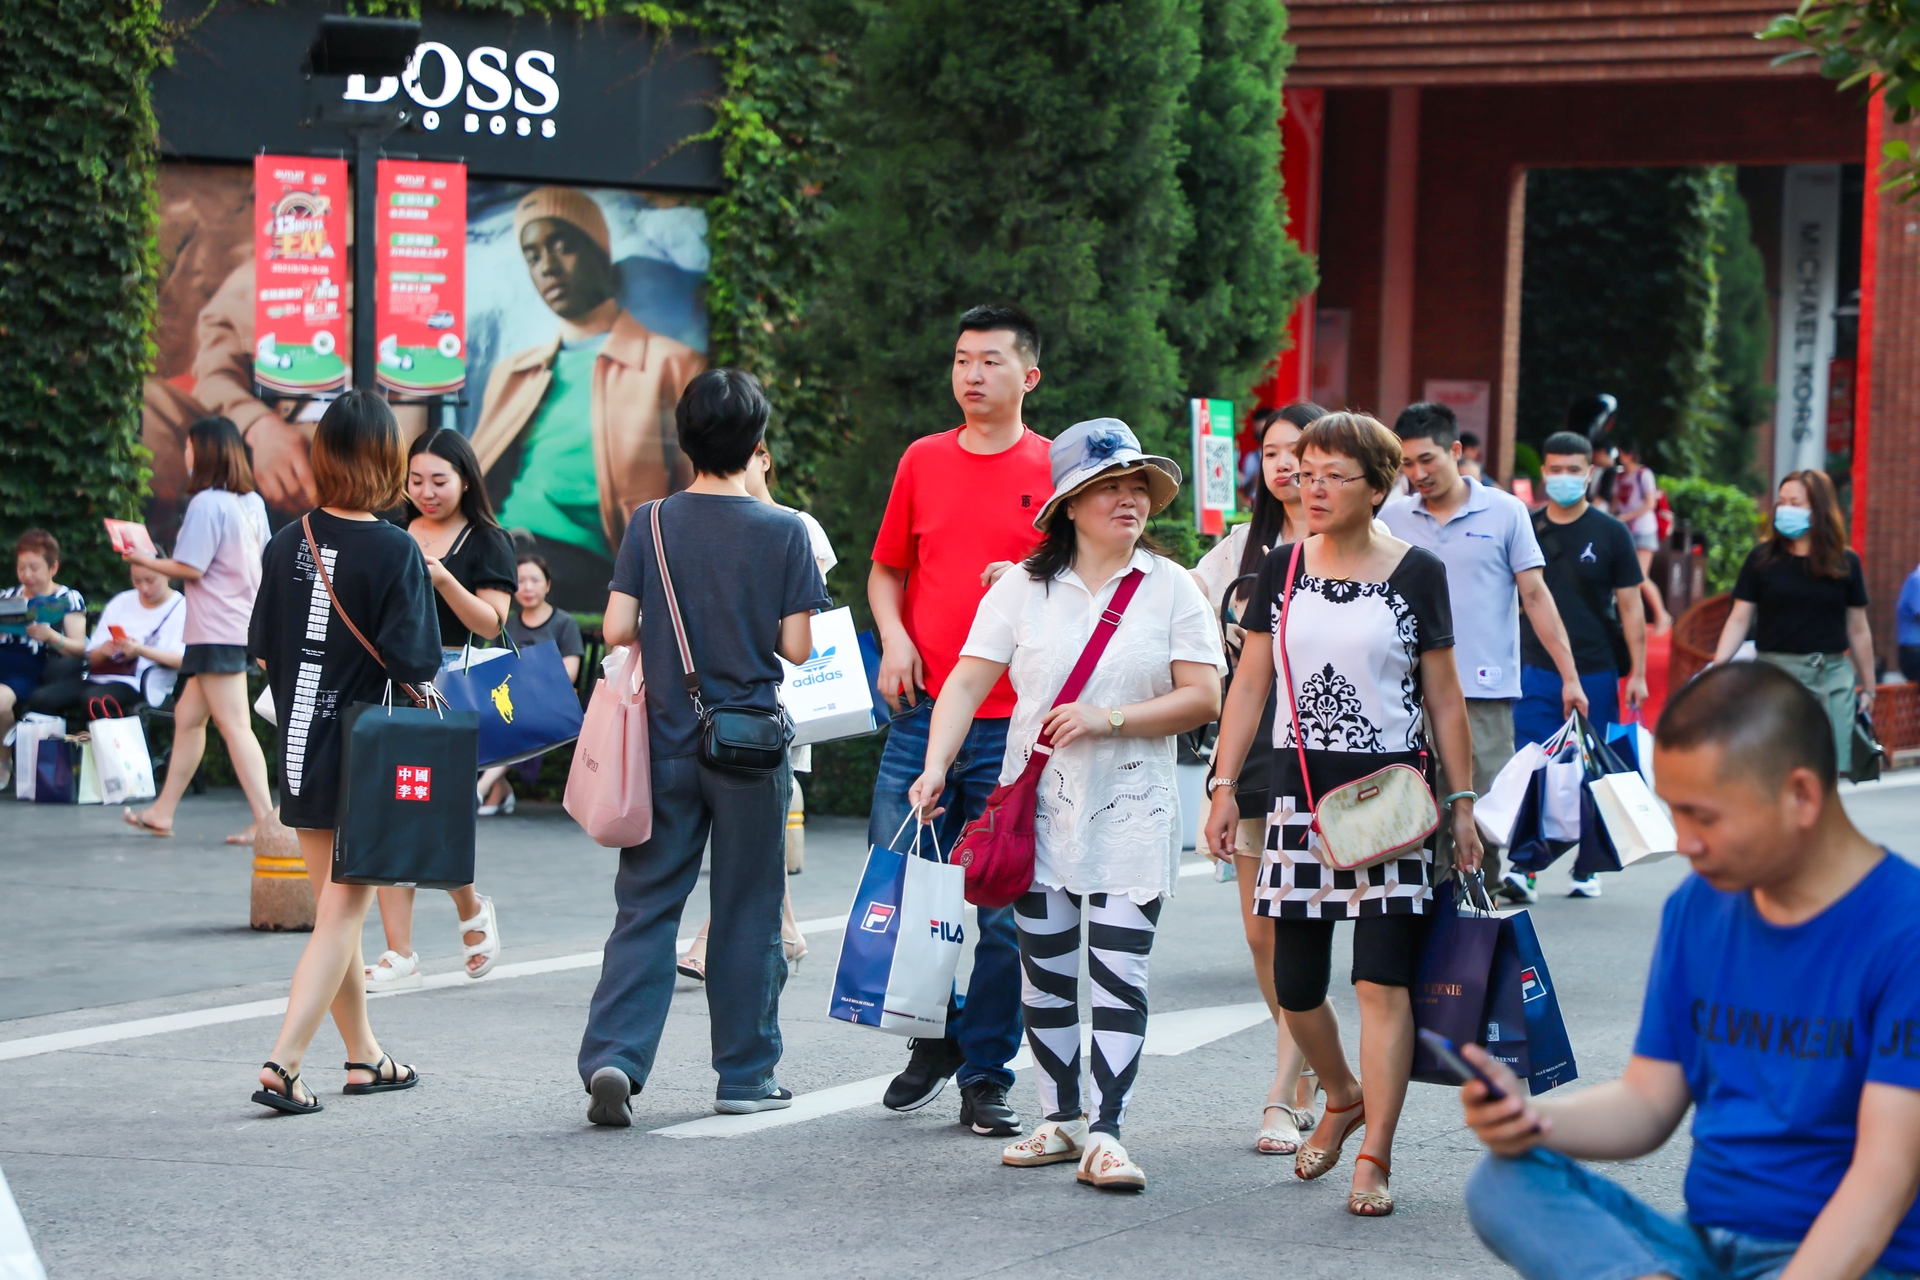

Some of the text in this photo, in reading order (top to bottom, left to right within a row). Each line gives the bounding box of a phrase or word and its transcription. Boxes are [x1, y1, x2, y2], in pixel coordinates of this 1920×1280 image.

[464, 113, 556, 138] BOSS
[1791, 222, 1820, 444] MICHAEL KORS
[792, 670, 843, 688] adidas
[398, 767, 428, 782] 中國
[398, 784, 428, 799] 李寧
[930, 919, 964, 944] FILA
